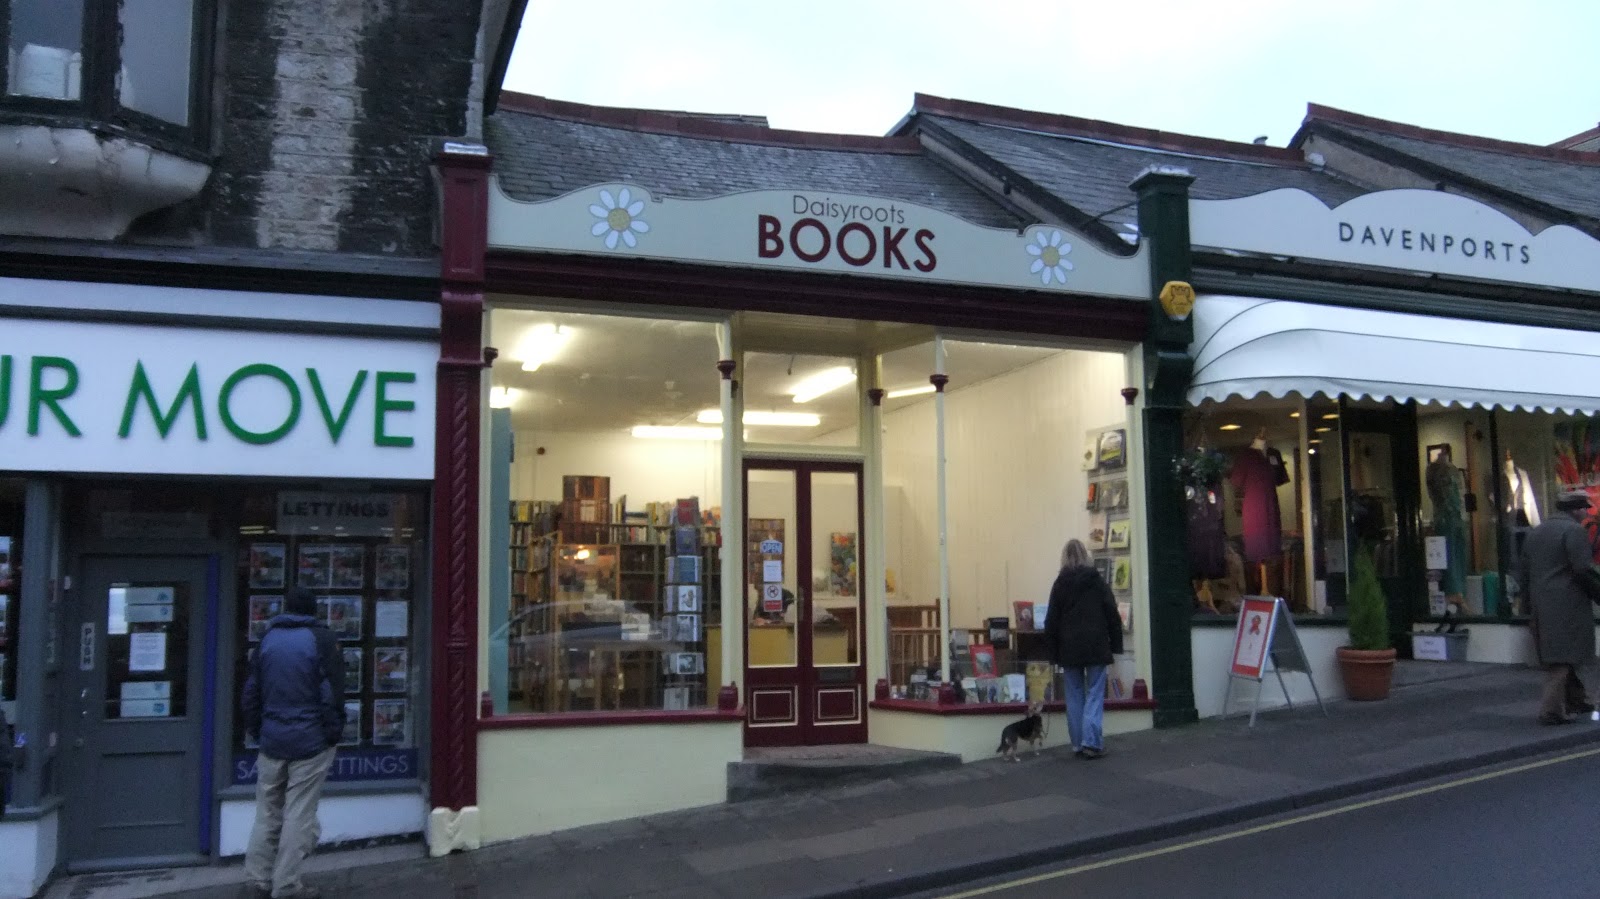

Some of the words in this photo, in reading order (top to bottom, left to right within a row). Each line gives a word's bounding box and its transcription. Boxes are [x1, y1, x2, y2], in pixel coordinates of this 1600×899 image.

[793, 195, 905, 224] Daisyroots
[758, 214, 937, 273] BOOKS
[1339, 222, 1530, 264] DAVENPORTS
[0, 355, 82, 437] R
[118, 358, 417, 447] MOVE
[283, 501, 390, 518] LETTINGS
[762, 542, 782, 553] OPEN
[327, 755, 408, 776] TTINGS
